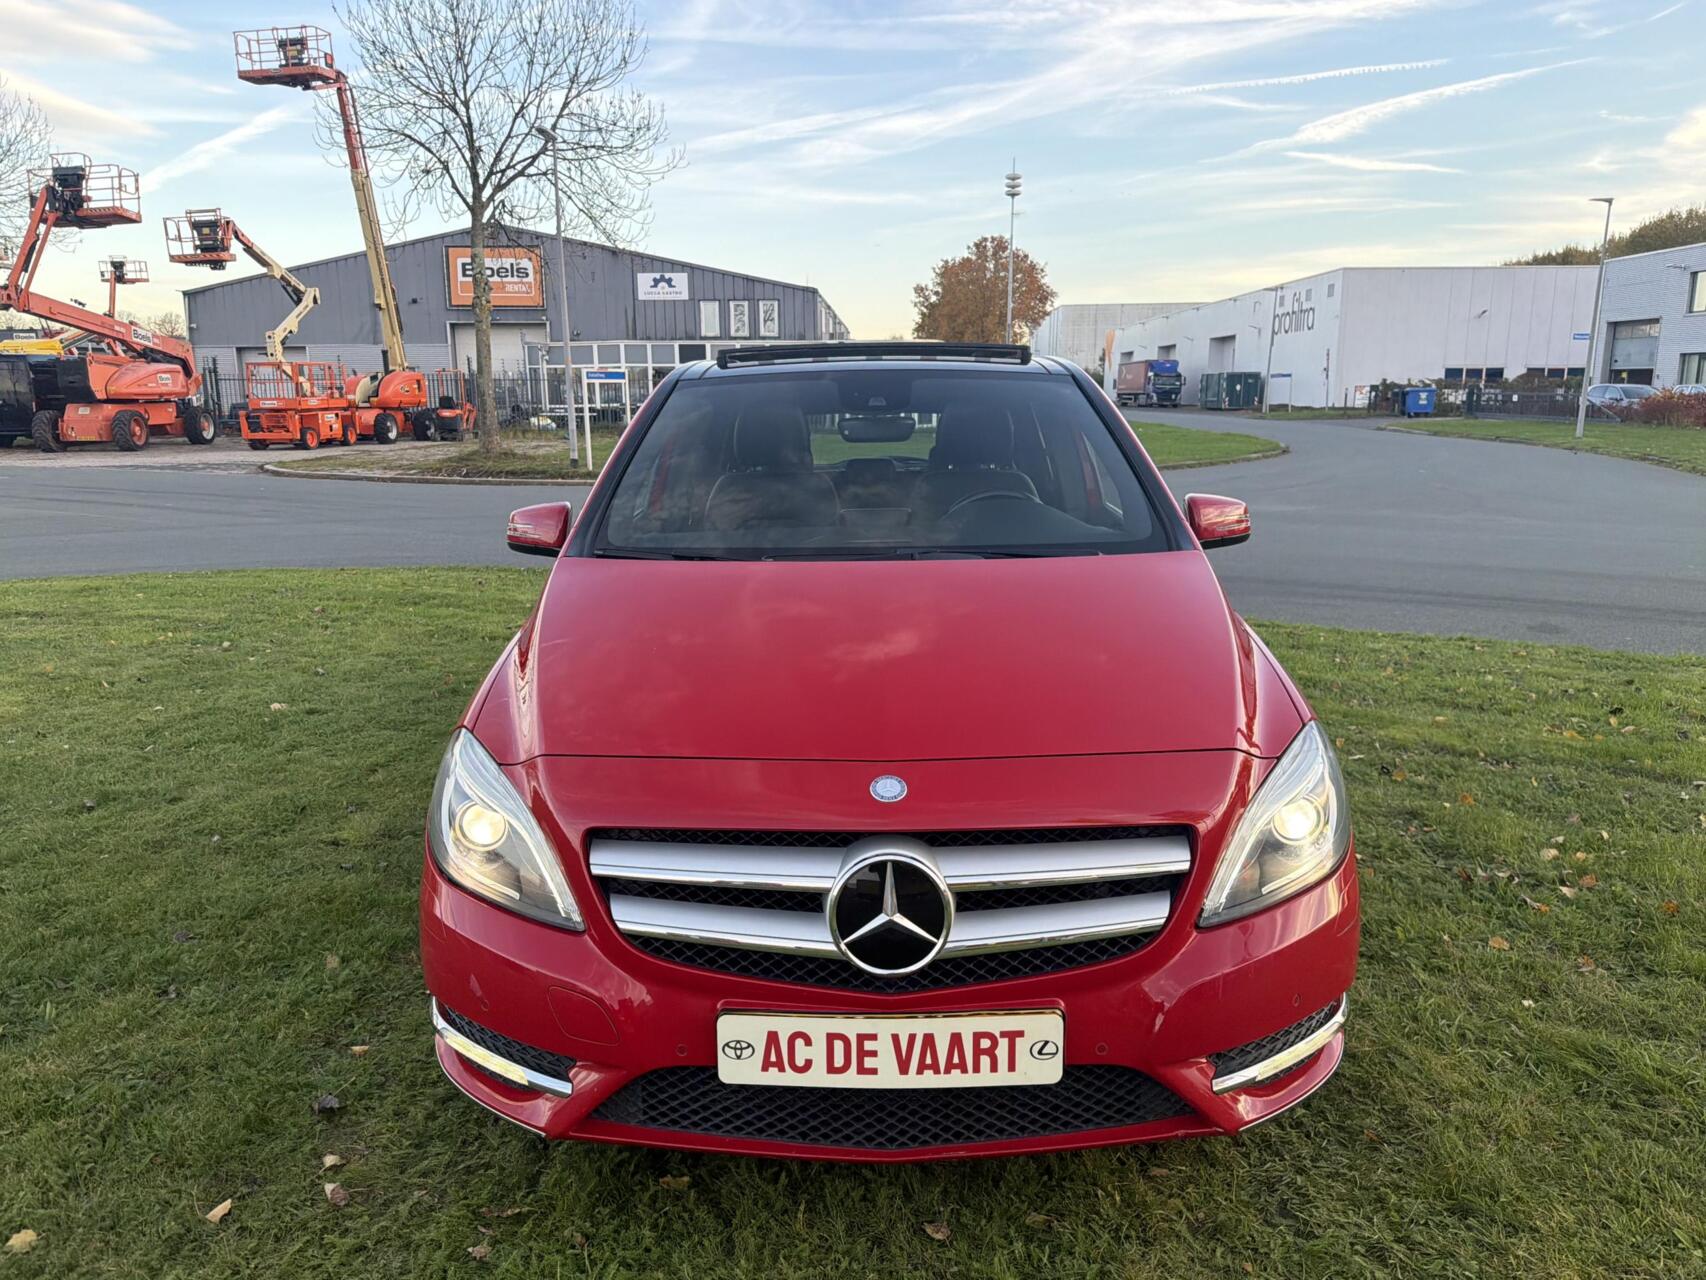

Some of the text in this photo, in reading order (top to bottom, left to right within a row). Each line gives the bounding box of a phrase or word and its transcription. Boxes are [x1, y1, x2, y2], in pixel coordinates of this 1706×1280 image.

[760, 1030, 1025, 1076] AC DE VAART
